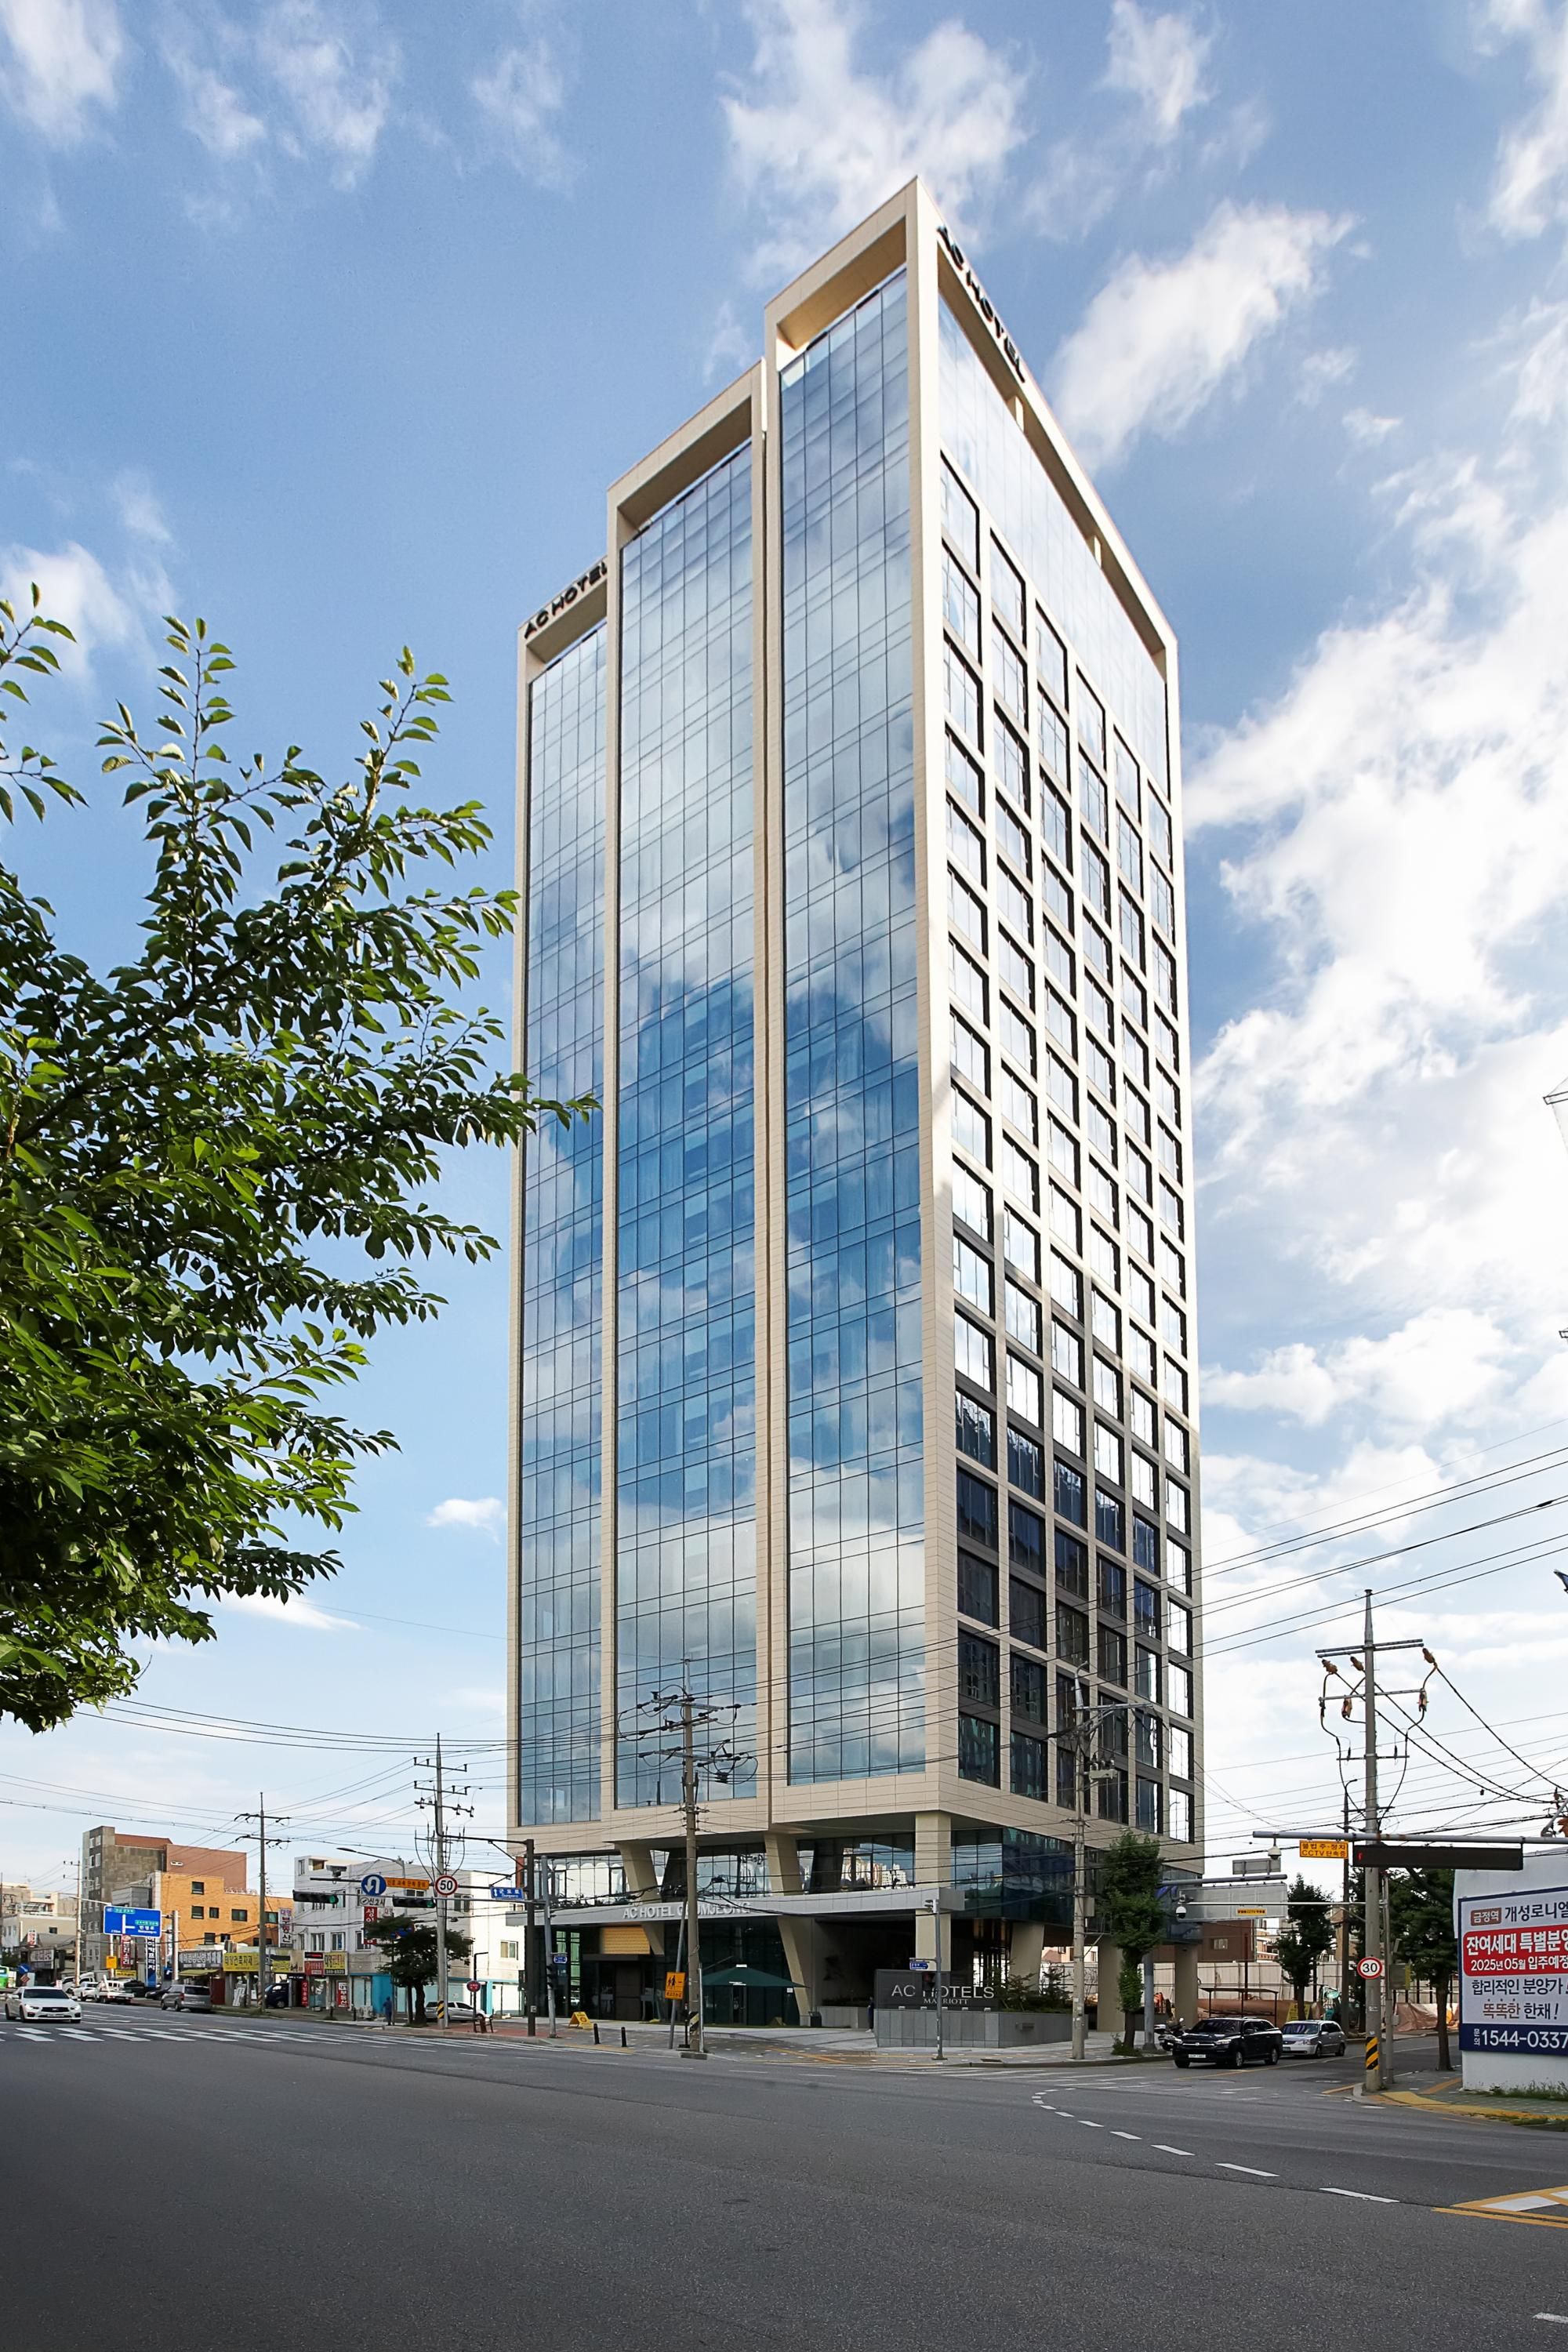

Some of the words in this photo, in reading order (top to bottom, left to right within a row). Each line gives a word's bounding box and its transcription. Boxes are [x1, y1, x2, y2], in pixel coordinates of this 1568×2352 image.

[524, 608, 549, 639] AC
[551, 561, 608, 615] HOTEL
[440, 1880, 453, 1890] 50
[622, 1907, 638, 1919] AC
[639, 1905, 675, 1918] HOTEL
[1473, 1911, 1499, 1923] 금정역
[281, 1917, 292, 1943] 부동산
[1466, 1933, 1517, 1956] 잔여세대
[1363, 1962, 1377, 1973] 30
[1470, 1959, 1503, 1972] 2025년
[1504, 1958, 1526, 1970] 05월
[891, 1984, 916, 1998] AC
[1472, 1979, 1519, 1995] 합리적인
[1523, 1977, 1563, 1995] 분양가
[1483, 2002, 1521, 2020] 똑똑한
[1481, 2029, 1568, 2049] 1544-0337
